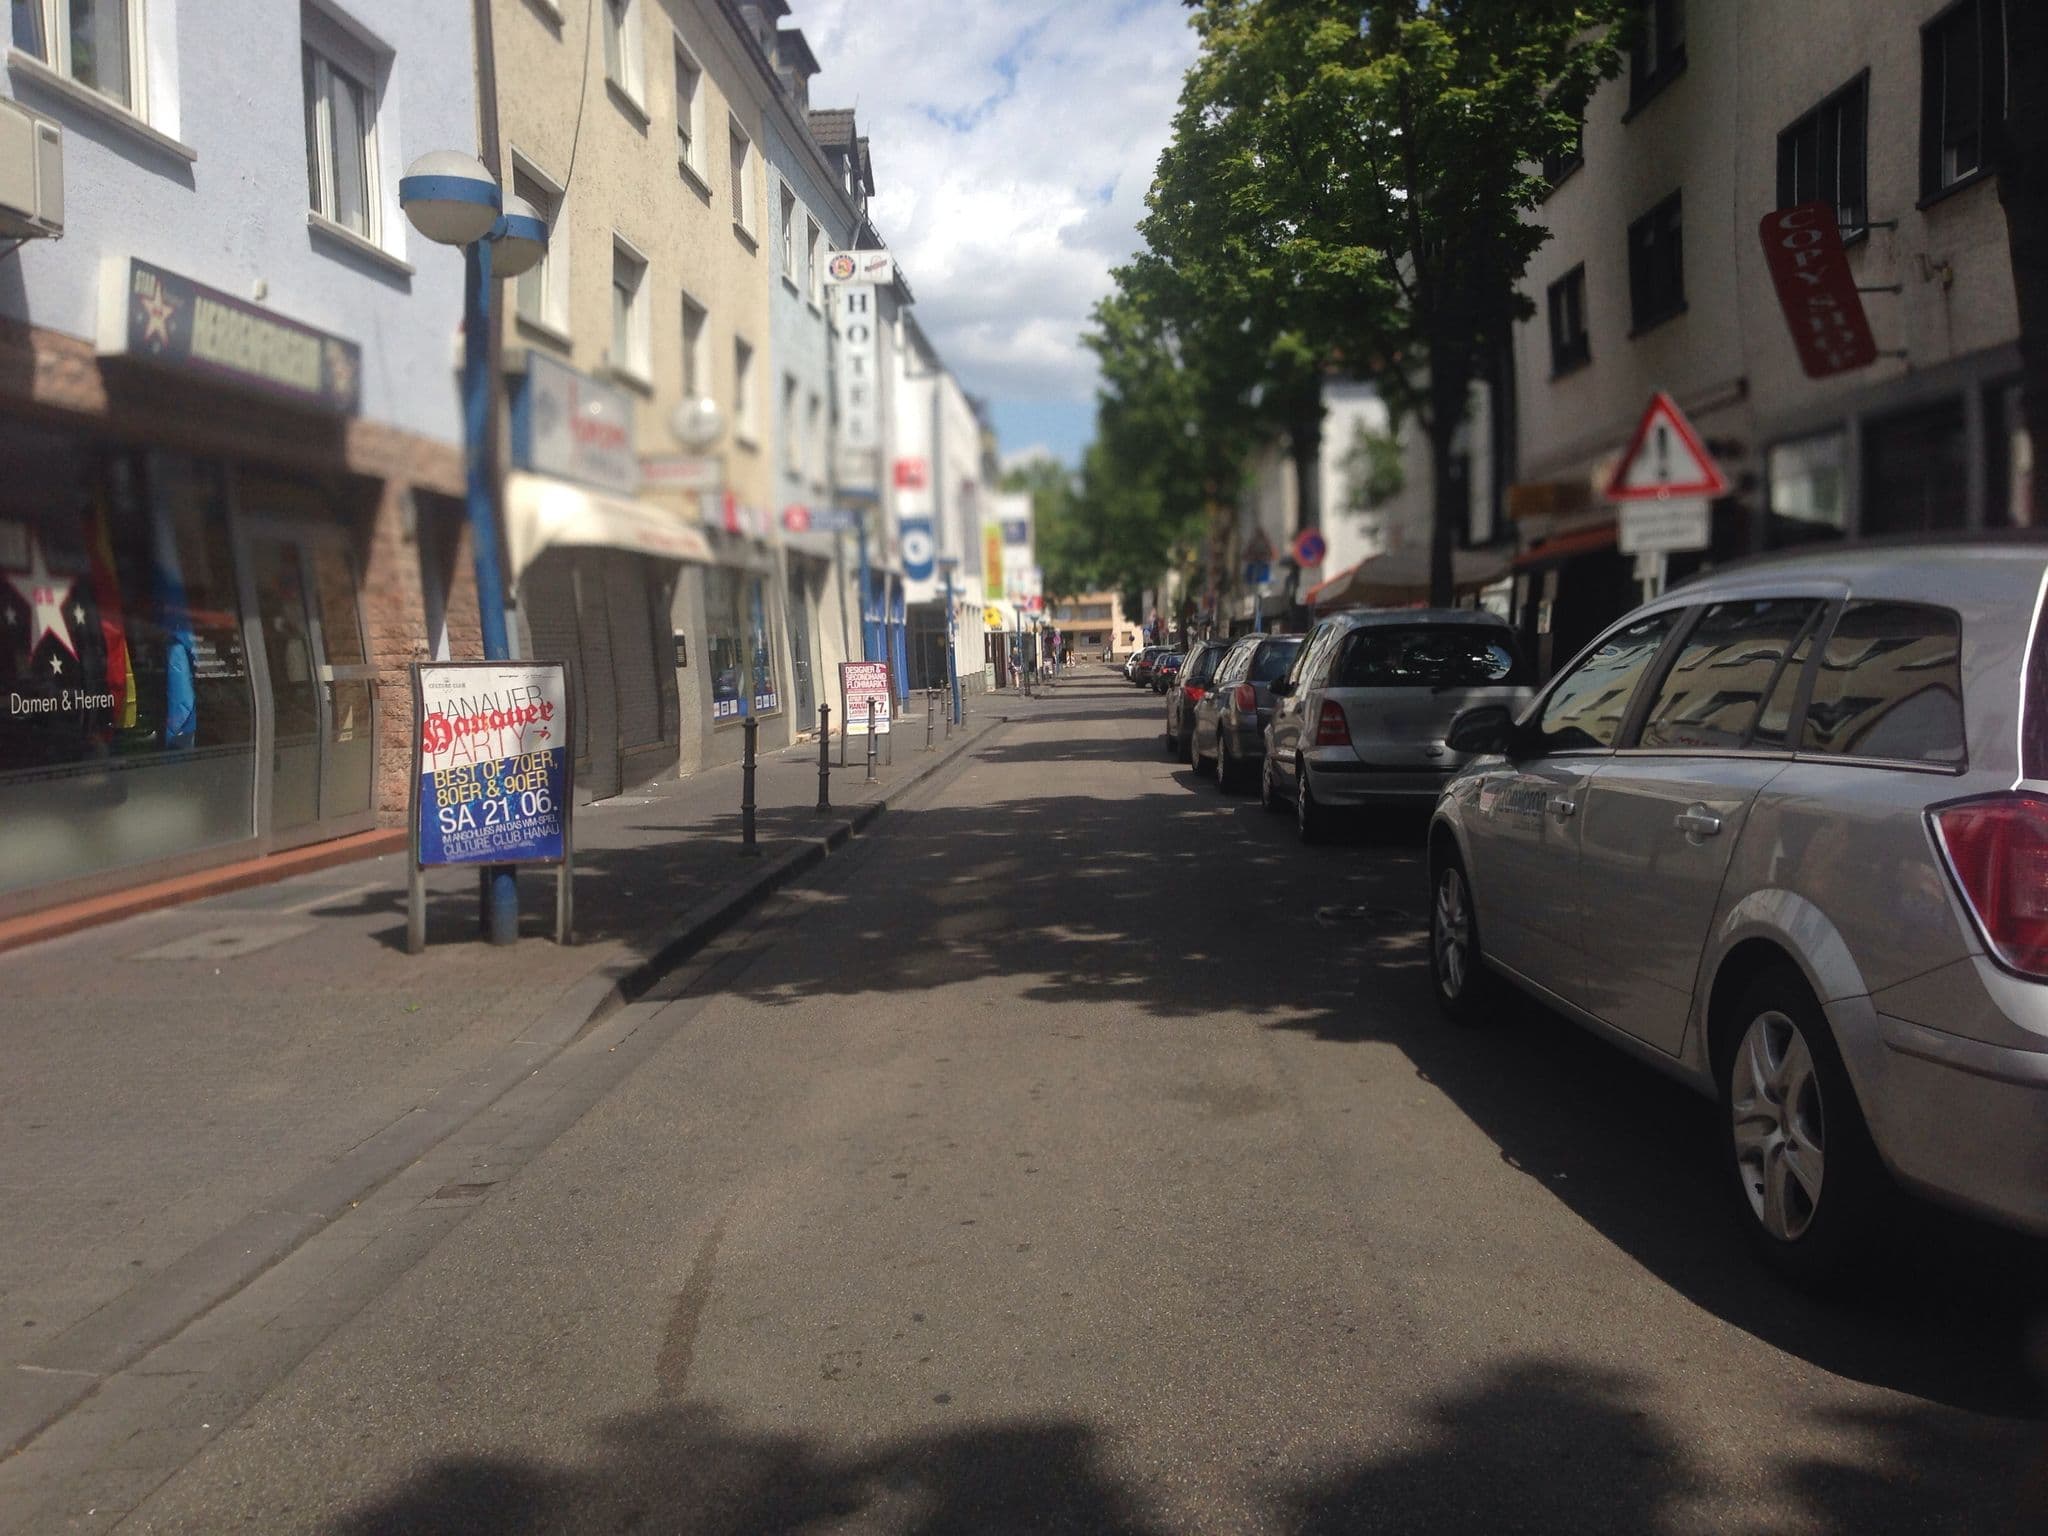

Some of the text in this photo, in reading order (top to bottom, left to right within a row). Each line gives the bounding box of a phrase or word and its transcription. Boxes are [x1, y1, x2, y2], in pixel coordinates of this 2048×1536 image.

[1778, 208, 1829, 286] COPY
[847, 293, 869, 434] HOTEL
[11, 689, 115, 714] Damen & Herren
[846, 680, 888, 689] FLOHMARKT
[434, 750, 558, 789] BEST OF 70ER,
[436, 769, 548, 807] 80ER & 90ER
[438, 804, 477, 834] SA
[443, 835, 491, 856] CULTURE
[492, 829, 522, 846] CLUB
[524, 823, 560, 840] HANAU
